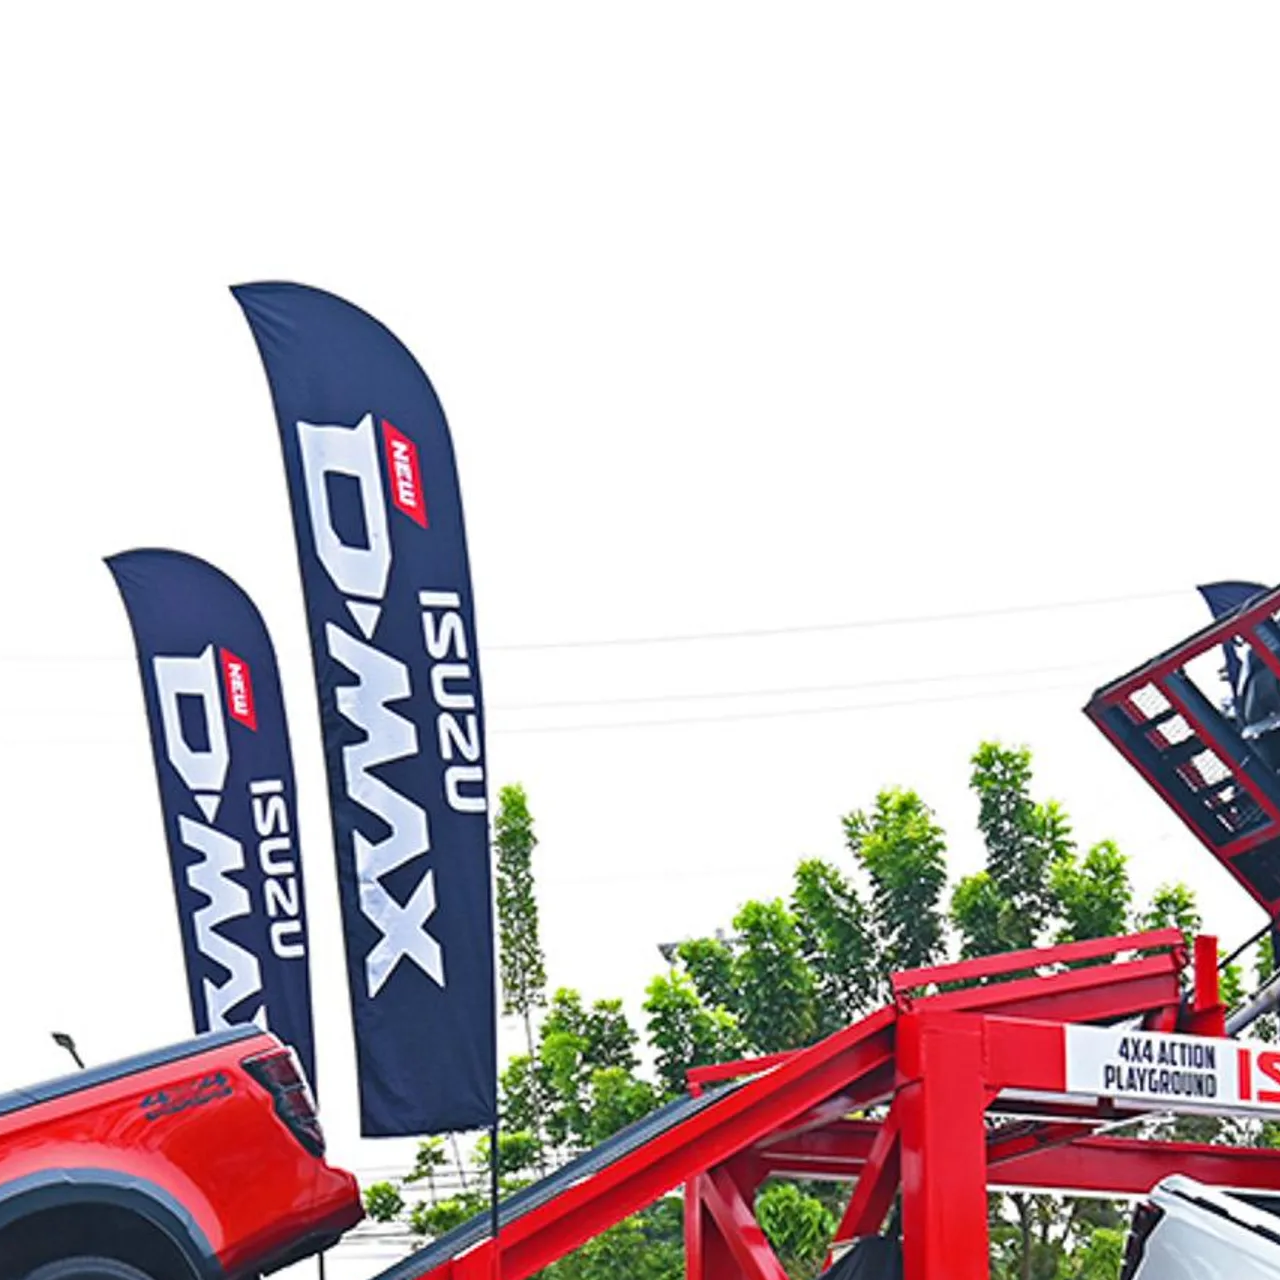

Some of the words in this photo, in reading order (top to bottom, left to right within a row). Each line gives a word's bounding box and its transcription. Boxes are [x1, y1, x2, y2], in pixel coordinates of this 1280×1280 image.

[390, 440, 417, 507] NEW
[228, 663, 249, 716] NEW
[418, 590, 487, 812] ISUZU
[152, 643, 268, 1034] D-MA
[249, 779, 306, 958] ISUZU
[1104, 1065, 1218, 1099] PLAYGROUND
[1118, 1036, 1153, 1063] 4X4
[1157, 1044, 1216, 1069] ACTION
